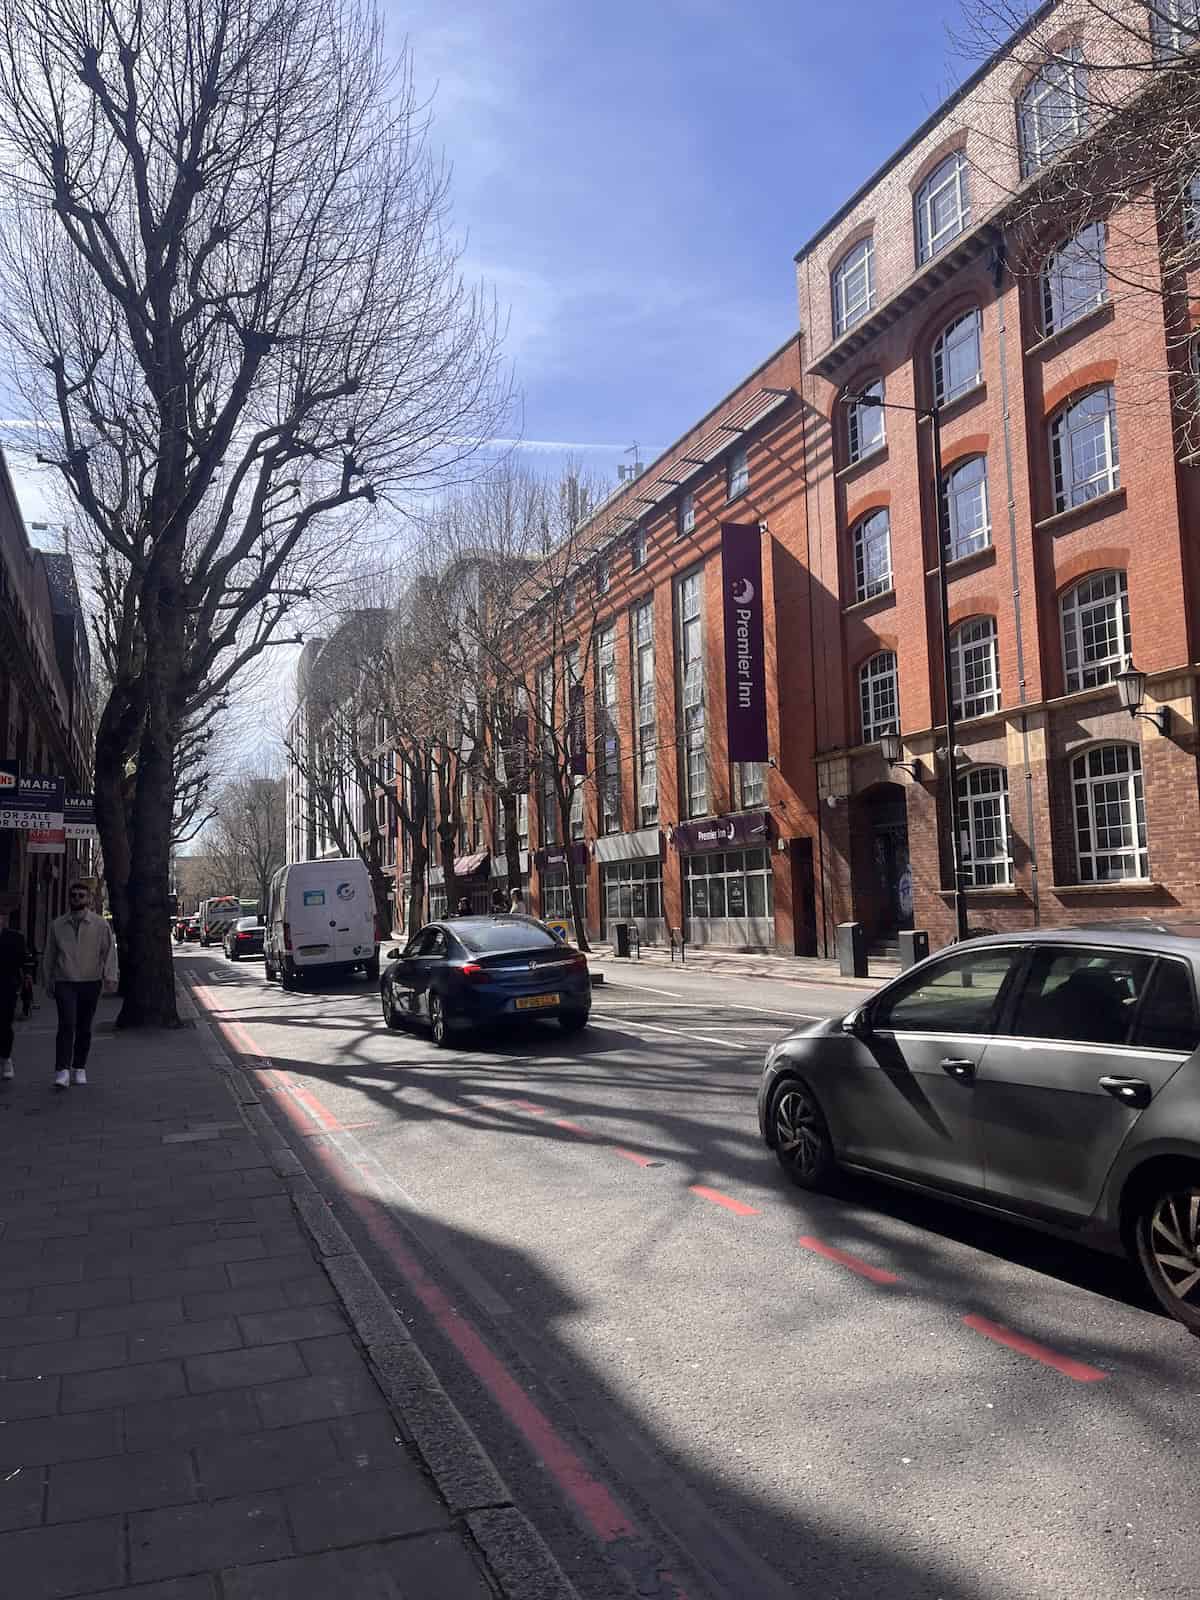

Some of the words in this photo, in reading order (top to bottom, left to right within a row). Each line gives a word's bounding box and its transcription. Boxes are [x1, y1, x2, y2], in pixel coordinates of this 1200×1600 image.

[736, 609, 752, 679] Premier
[738, 681, 753, 708] Inn
[23, 812, 50, 820] SALE
[14, 820, 29, 828] TO
[33, 821, 51, 829] LET
[698, 830, 717, 841] Premier
[717, 828, 727, 839] Inn
